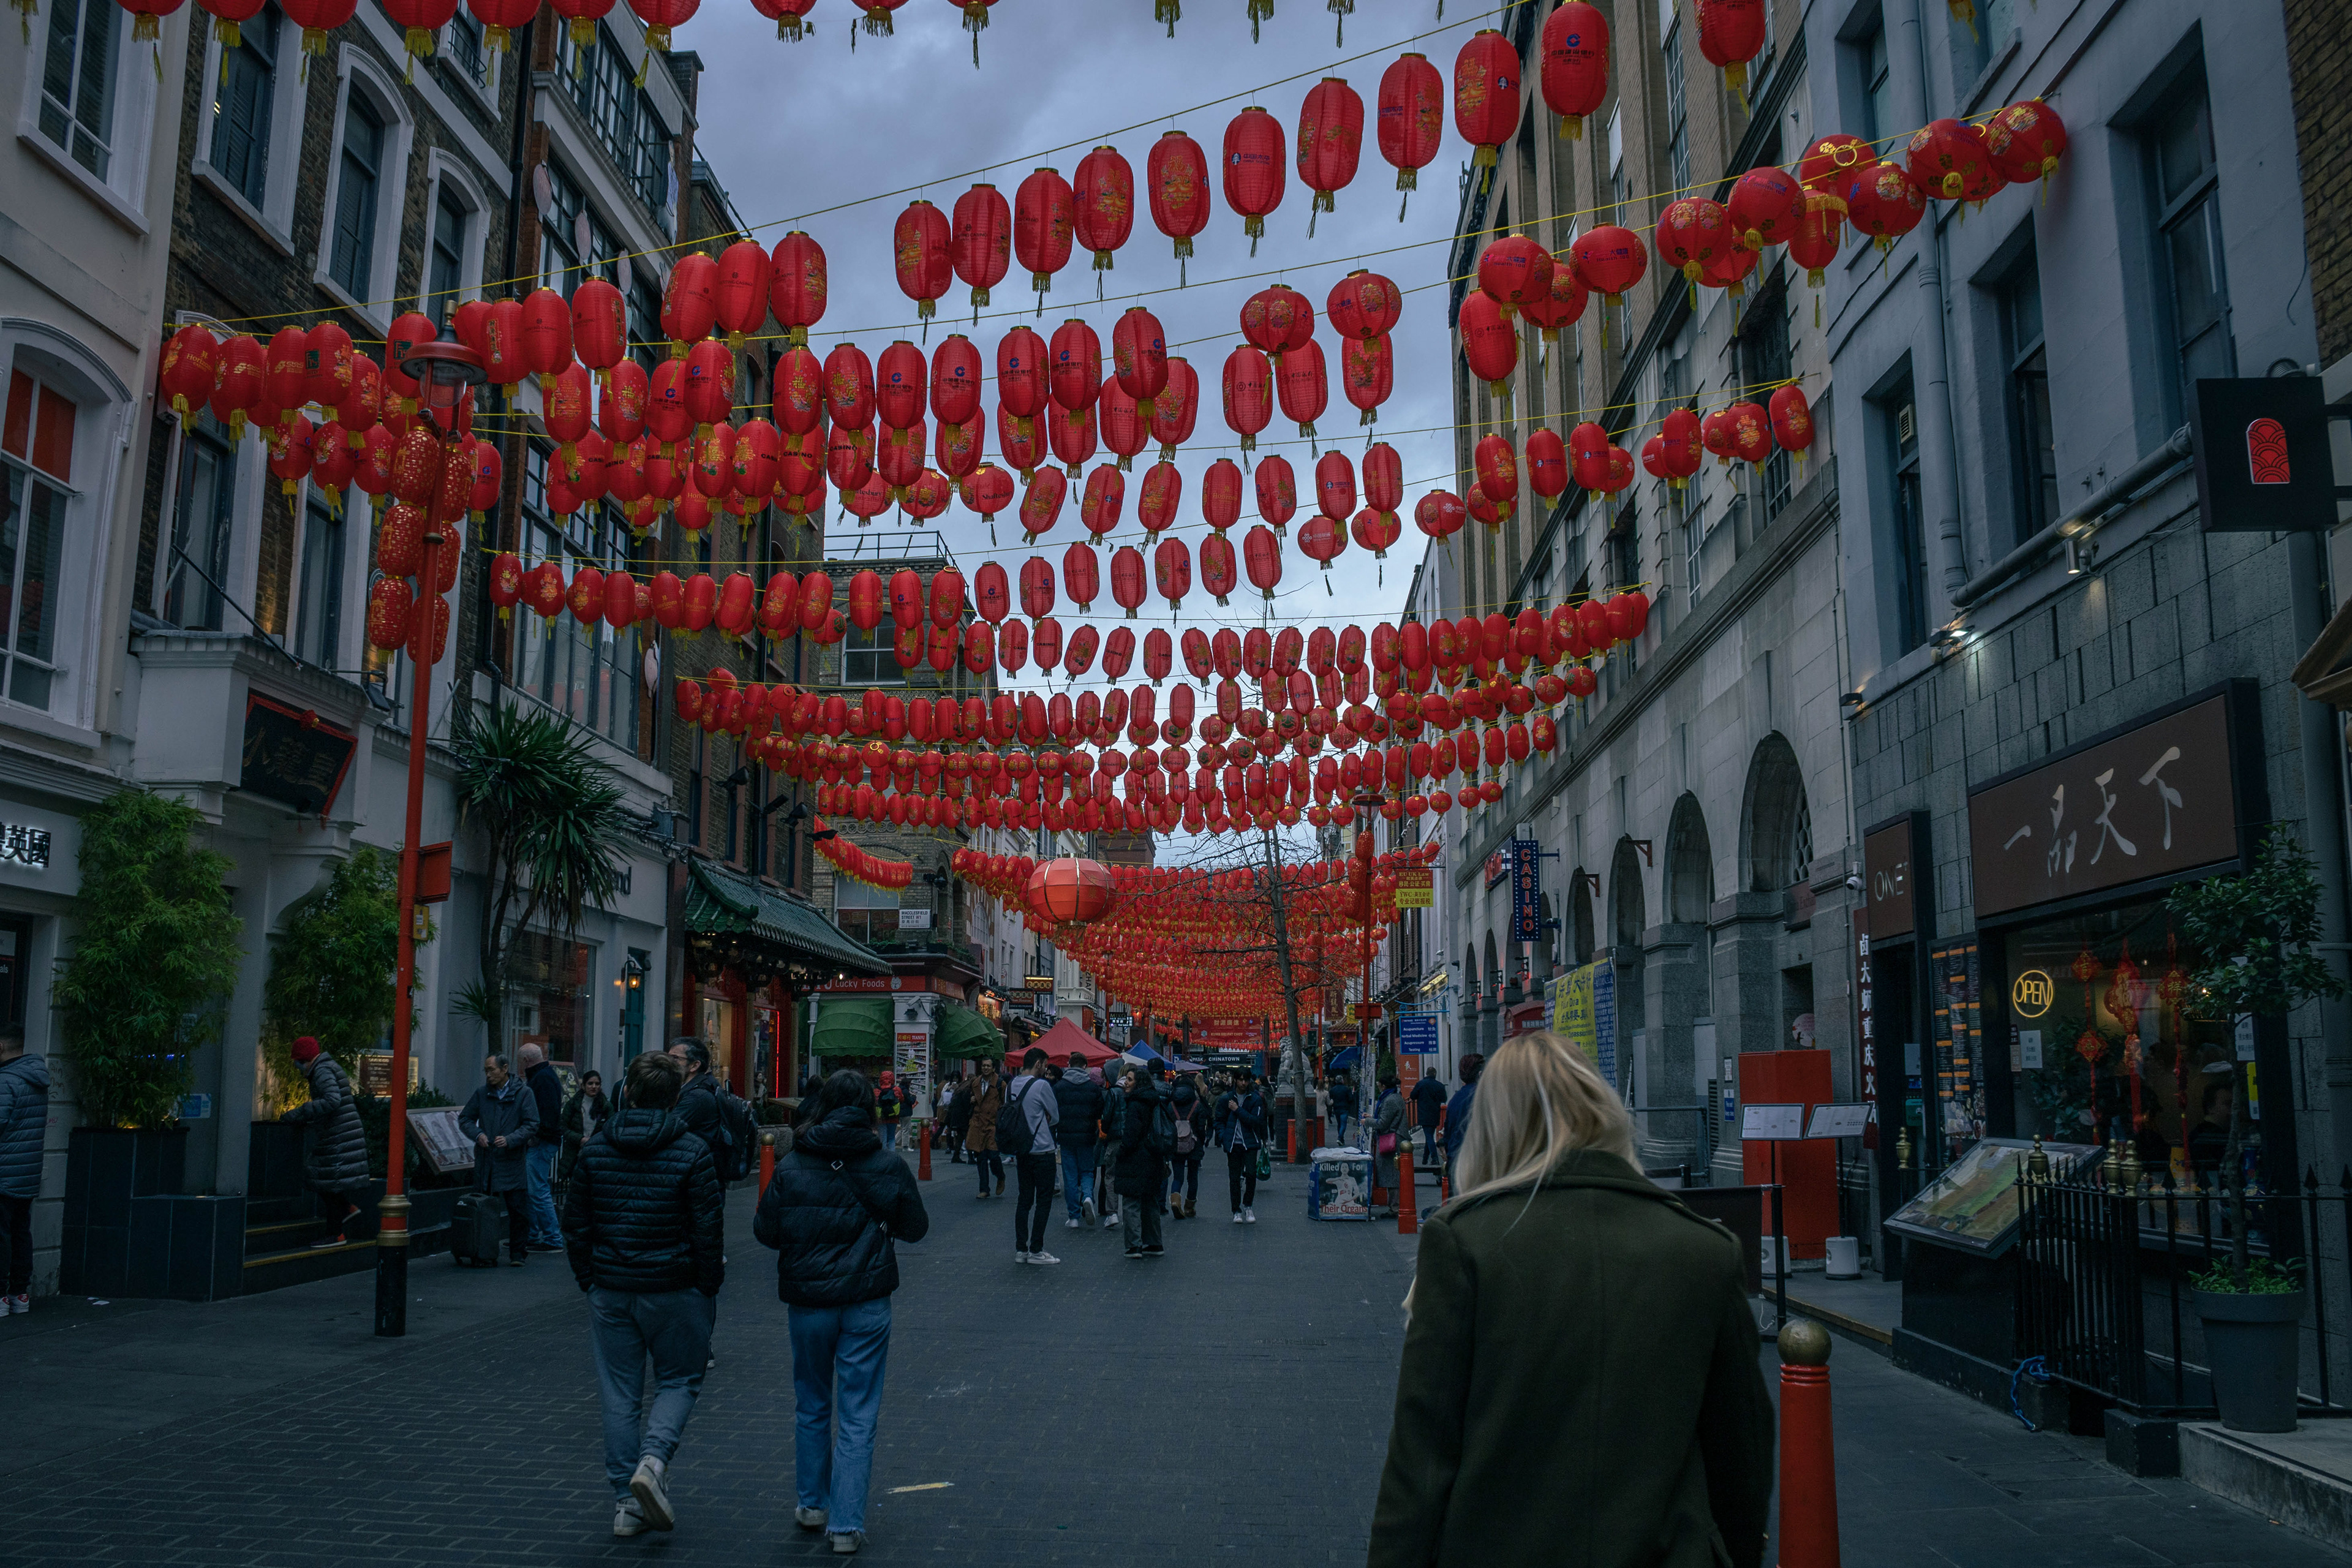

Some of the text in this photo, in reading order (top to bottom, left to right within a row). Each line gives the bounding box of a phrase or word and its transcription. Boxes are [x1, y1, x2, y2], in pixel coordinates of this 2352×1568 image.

[1520, 848, 1534, 932] CASINO
[835, 980, 858, 989] Lucky
[2013, 979, 2051, 1006] OPEN
[1319, 1163, 1363, 1171] Killed For
[1319, 1204, 1368, 1214] Their Organs
